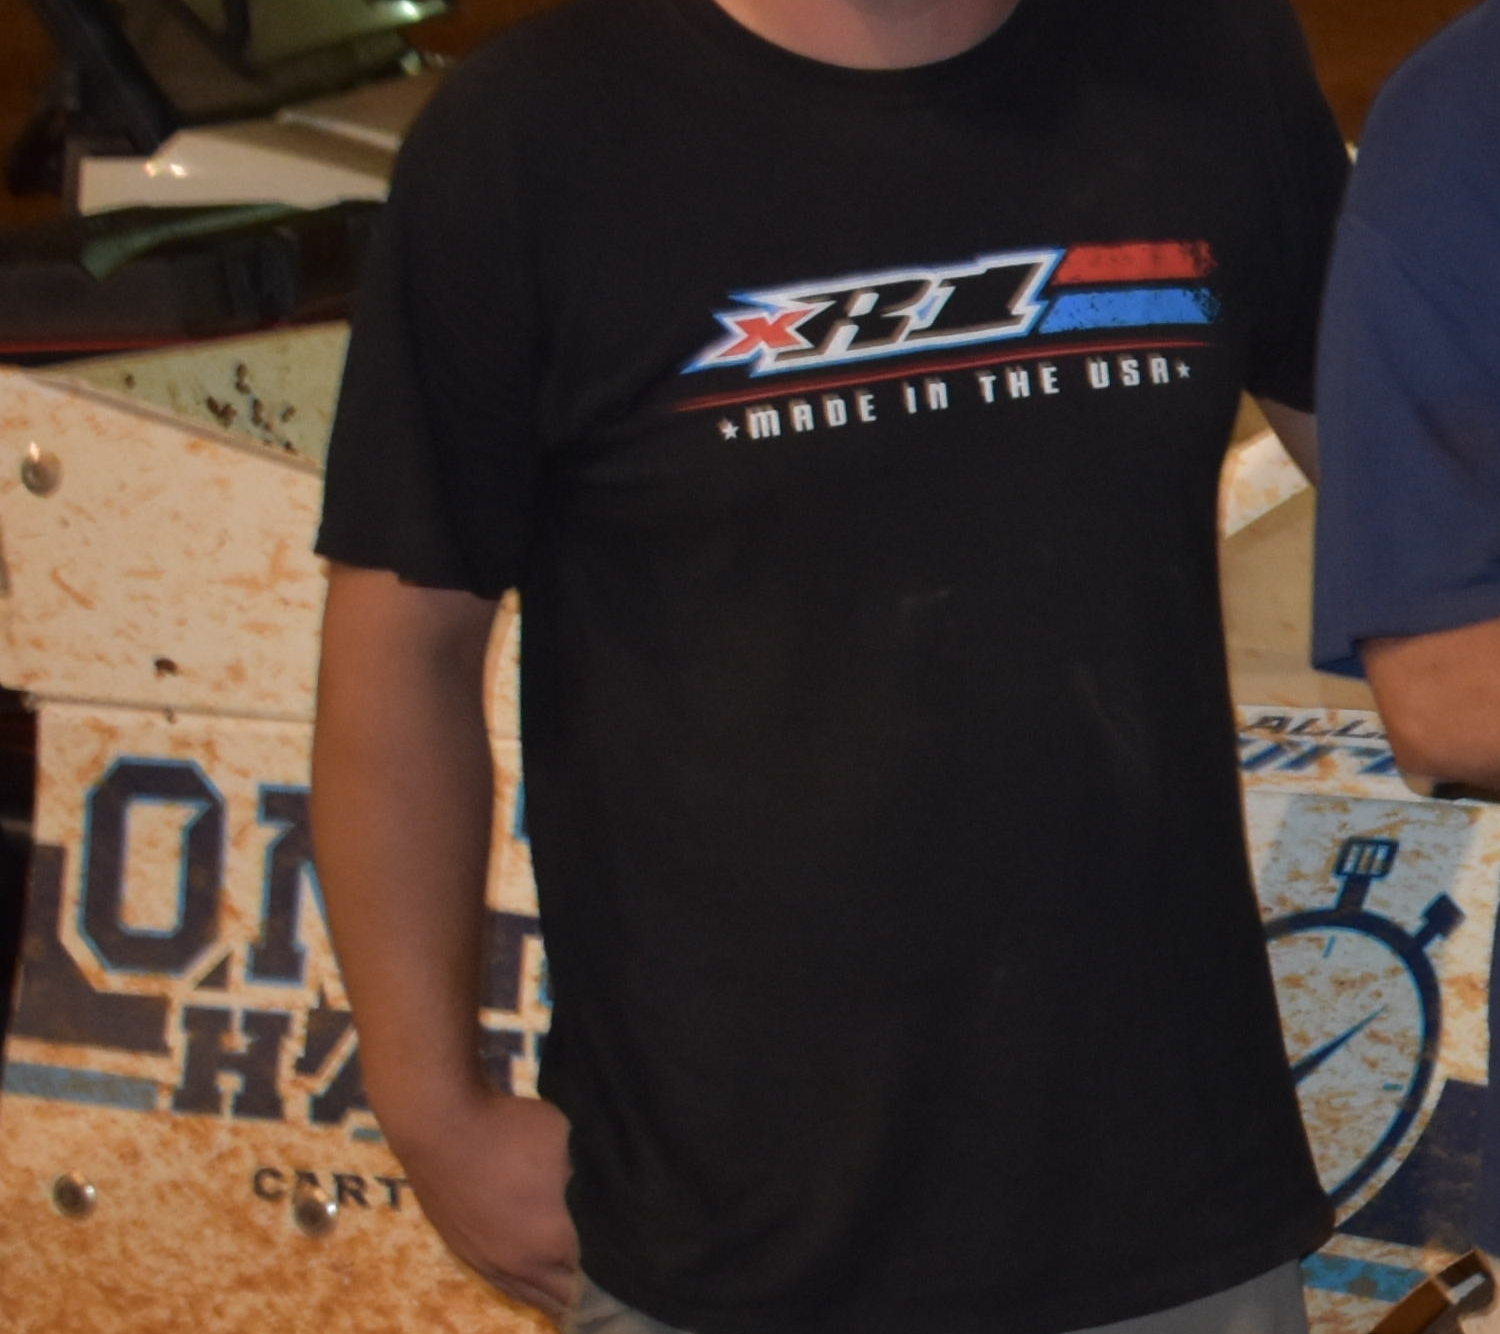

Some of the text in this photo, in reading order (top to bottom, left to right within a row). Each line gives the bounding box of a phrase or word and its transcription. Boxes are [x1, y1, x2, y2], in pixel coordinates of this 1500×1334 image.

[748, 355, 1170, 441] MADE IN THE USA
